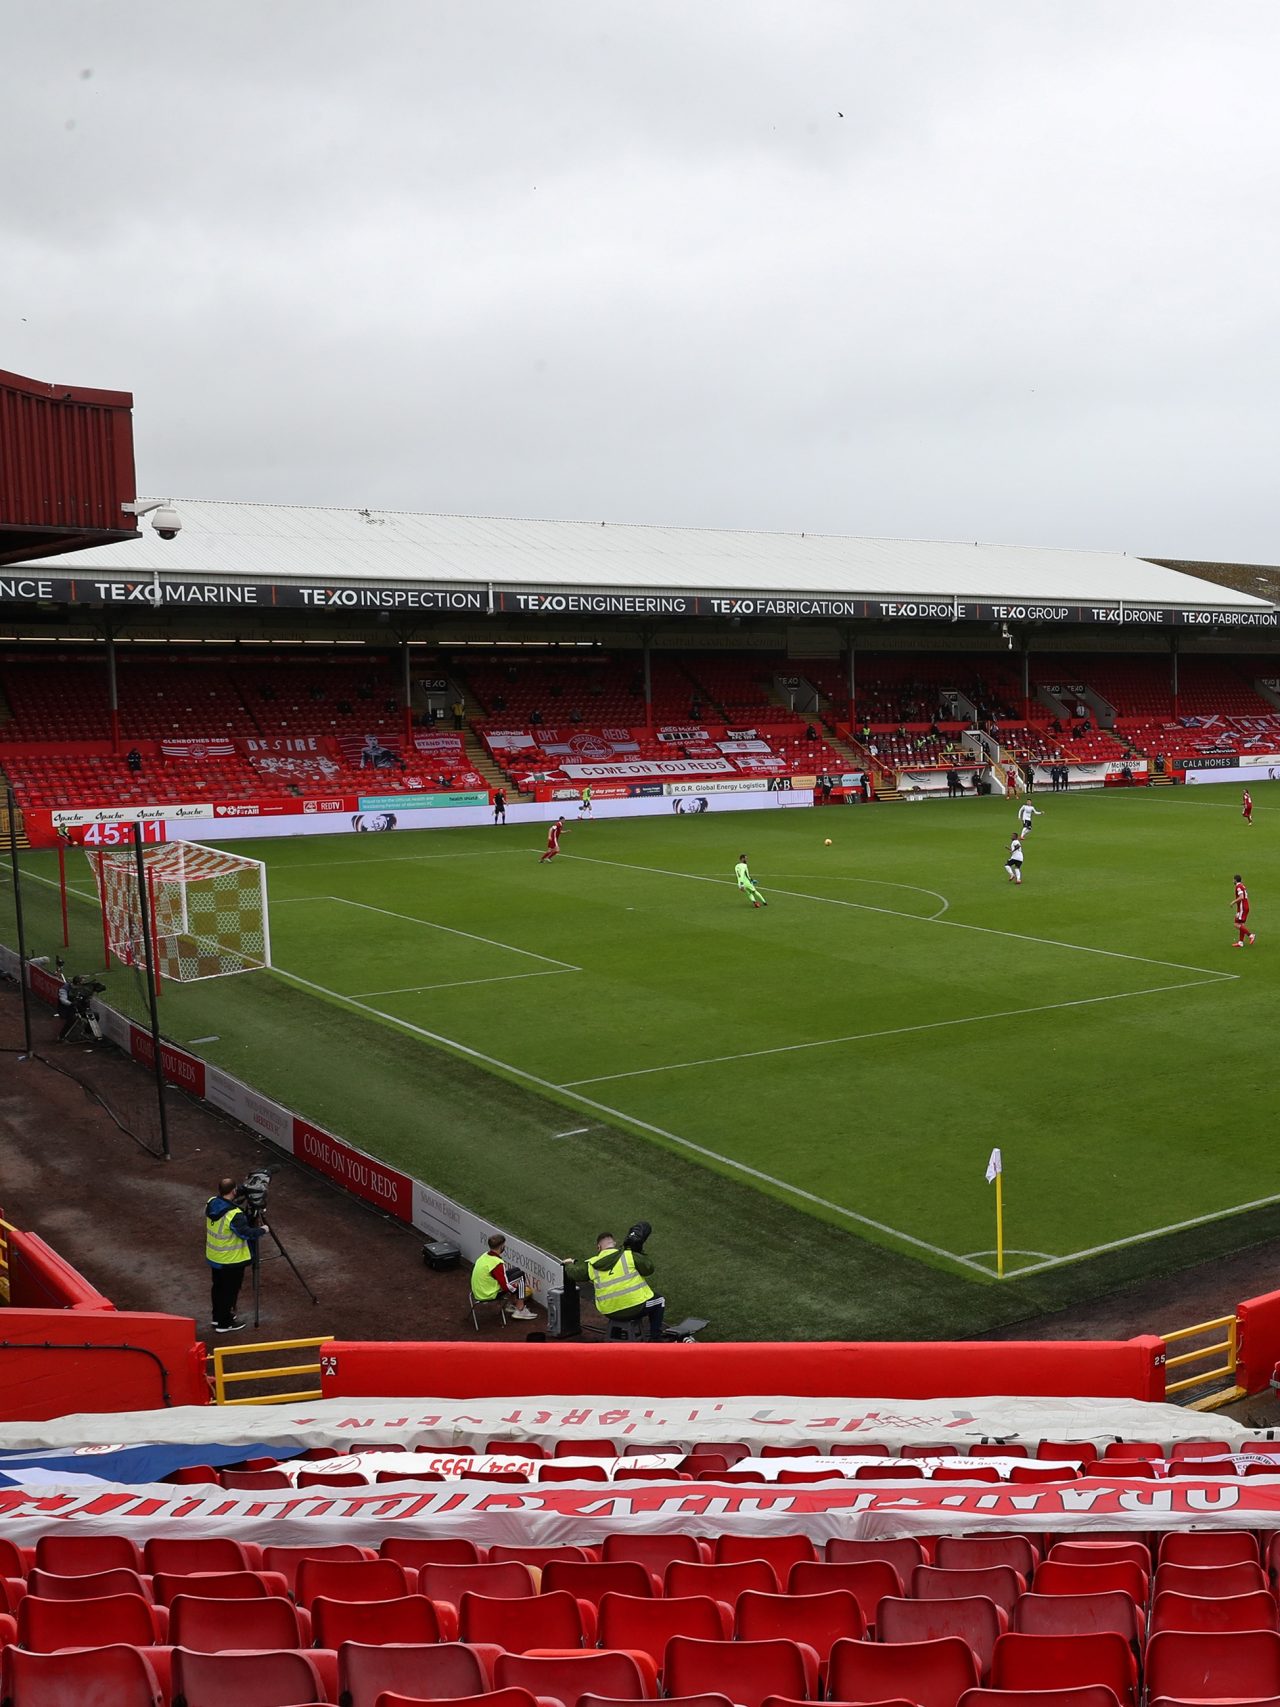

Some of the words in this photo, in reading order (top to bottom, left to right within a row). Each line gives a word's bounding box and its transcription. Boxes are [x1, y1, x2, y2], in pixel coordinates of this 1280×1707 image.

[95, 582, 163, 602] TEXO
[167, 584, 257, 606] MARINE
[300, 589, 359, 606] TEXO
[360, 590, 481, 609] INSPECTION
[516, 594, 566, 610] TEXO
[568, 595, 686, 613] ENGINEERING
[711, 598, 754, 614] TEXO
[756, 600, 854, 616] FABRICATION
[880, 603, 917, 617] TEXO
[919, 604, 966, 619] DRONE
[992, 605, 1026, 619] TEXO
[1027, 607, 1069, 621] GROUP
[1092, 608, 1121, 622] TEXO
[1124, 610, 1163, 623] DRONE
[1182, 611, 1211, 624] TEXO
[1212, 612, 1278, 626] FABRICATION
[602, 729, 630, 740] REDS
[581, 762, 627, 776] COME
[628, 763, 651, 775] ON
[654, 760, 688, 773] YOU
[690, 760, 727, 771] REDS
[1183, 760, 1204, 768] CALA
[1204, 759, 1231, 767] HOMES
[714, 784, 732, 792] Energy
[733, 782, 766, 790] Logistics
[321, 801, 340, 810] REDTV
[178, 1062, 196, 1083] REDS
[303, 1133, 331, 1161] COME
[331, 1147, 346, 1168] ON
[346, 1157, 369, 1187] YOU
[371, 1172, 399, 1203] REDS
[504, 1247, 547, 1281] SUPPORTERS
[321, 1356, 337, 1366] 25
[1154, 1354, 1166, 1366] 25
